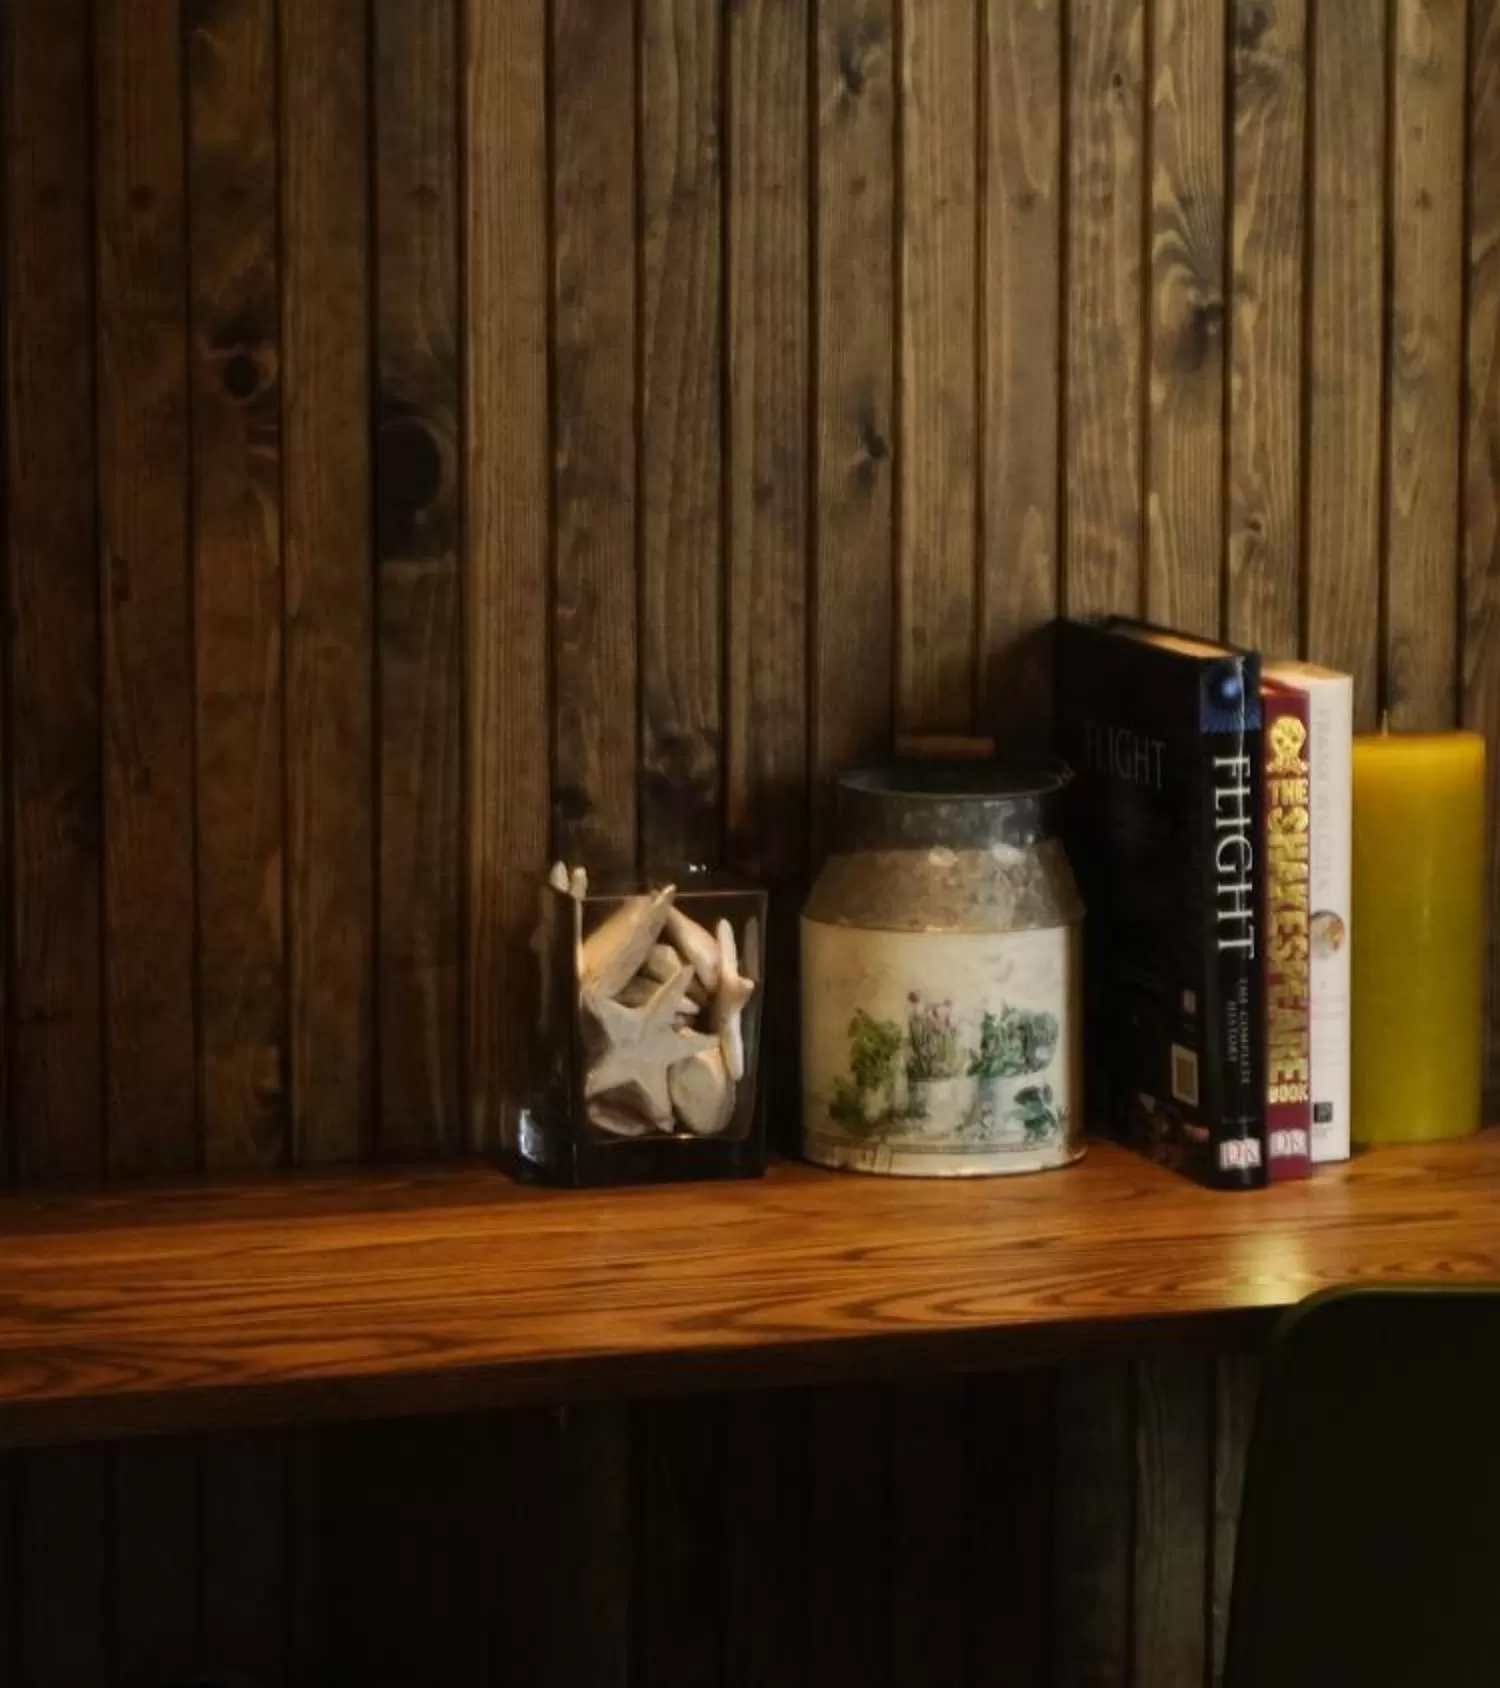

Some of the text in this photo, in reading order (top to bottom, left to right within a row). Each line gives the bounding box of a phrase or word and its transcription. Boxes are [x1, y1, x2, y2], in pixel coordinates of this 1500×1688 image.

[1083, 717, 1167, 790] FLIGHT
[1267, 778, 1308, 804] THE
[1212, 755, 1255, 960] FLIGHT
[1266, 805, 1309, 1082] SHAKESPEARE
[1239, 977, 1249, 1004] THE
[1268, 1083, 1308, 1103] BOOK
